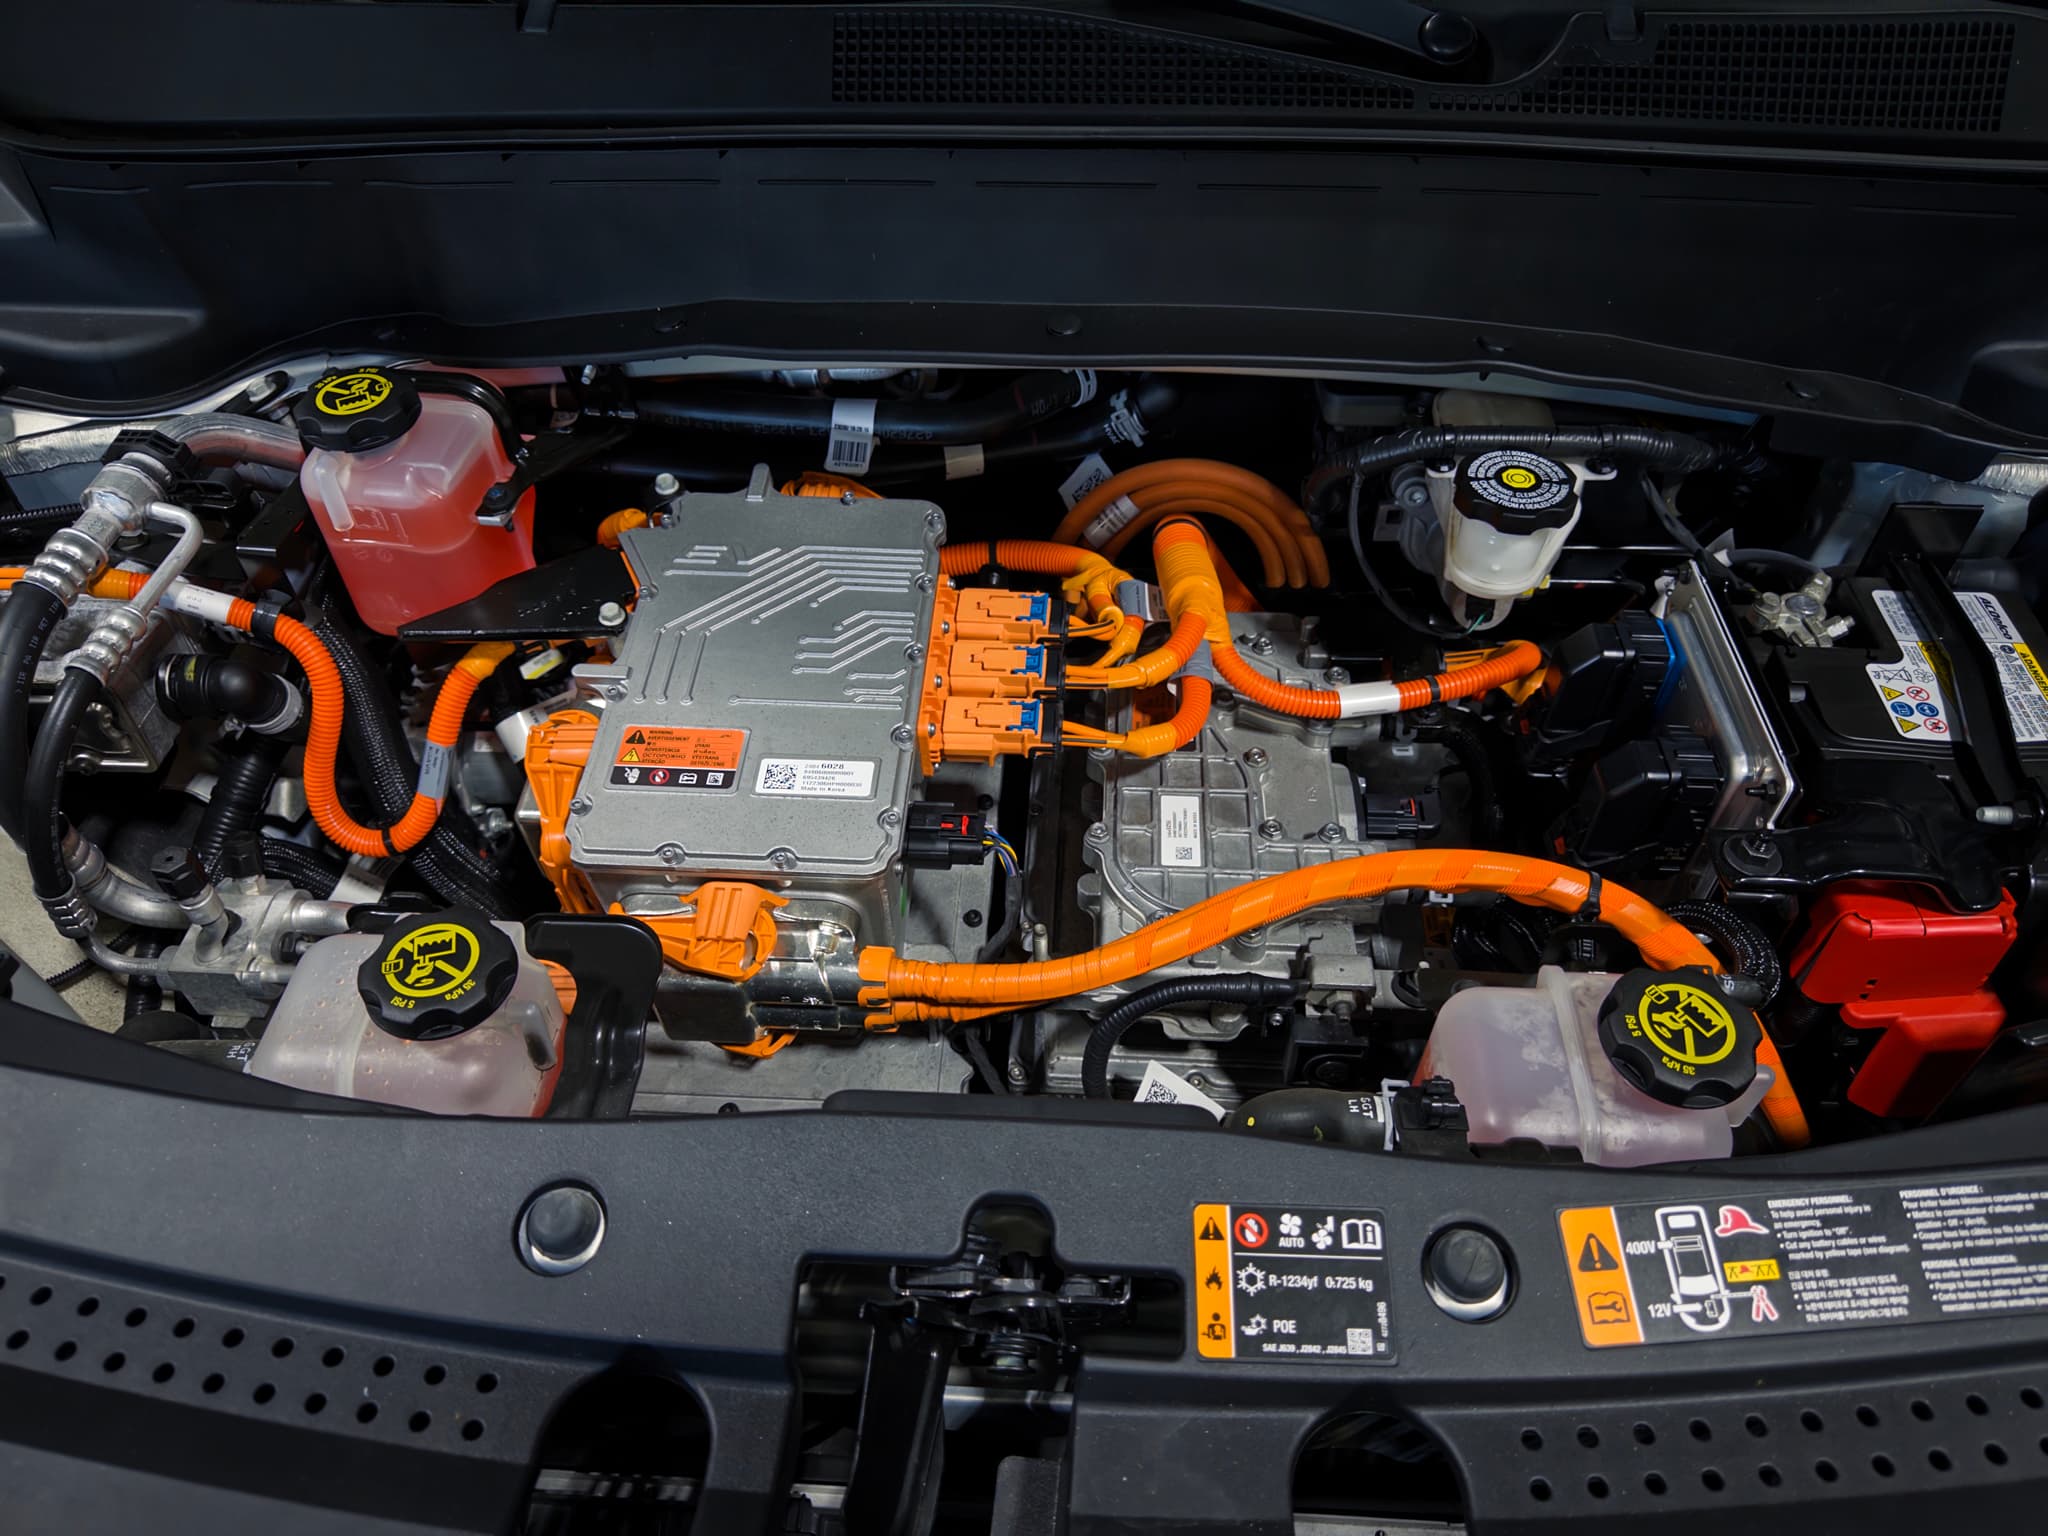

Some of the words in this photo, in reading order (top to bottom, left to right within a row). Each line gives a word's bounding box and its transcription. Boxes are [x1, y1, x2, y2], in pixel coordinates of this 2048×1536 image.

[390, 995, 408, 1008] PSI
[444, 988, 465, 1001] kPa
[407, 999, 416, 1009] 5
[1624, 1014, 1639, 1030] PSI
[1661, 1055, 1682, 1072] kPa
[1682, 1065, 1697, 1076] 35
[1347, 1099, 1360, 1113] LH
[1278, 1237, 1305, 1249] AUTO
[1625, 1241, 1656, 1255] 400V
[1268, 1274, 1319, 1290] R-1234yf
[1358, 1277, 1373, 1292] kg
[1648, 1303, 1672, 1318] 12V
[1272, 1319, 1297, 1334] POE
